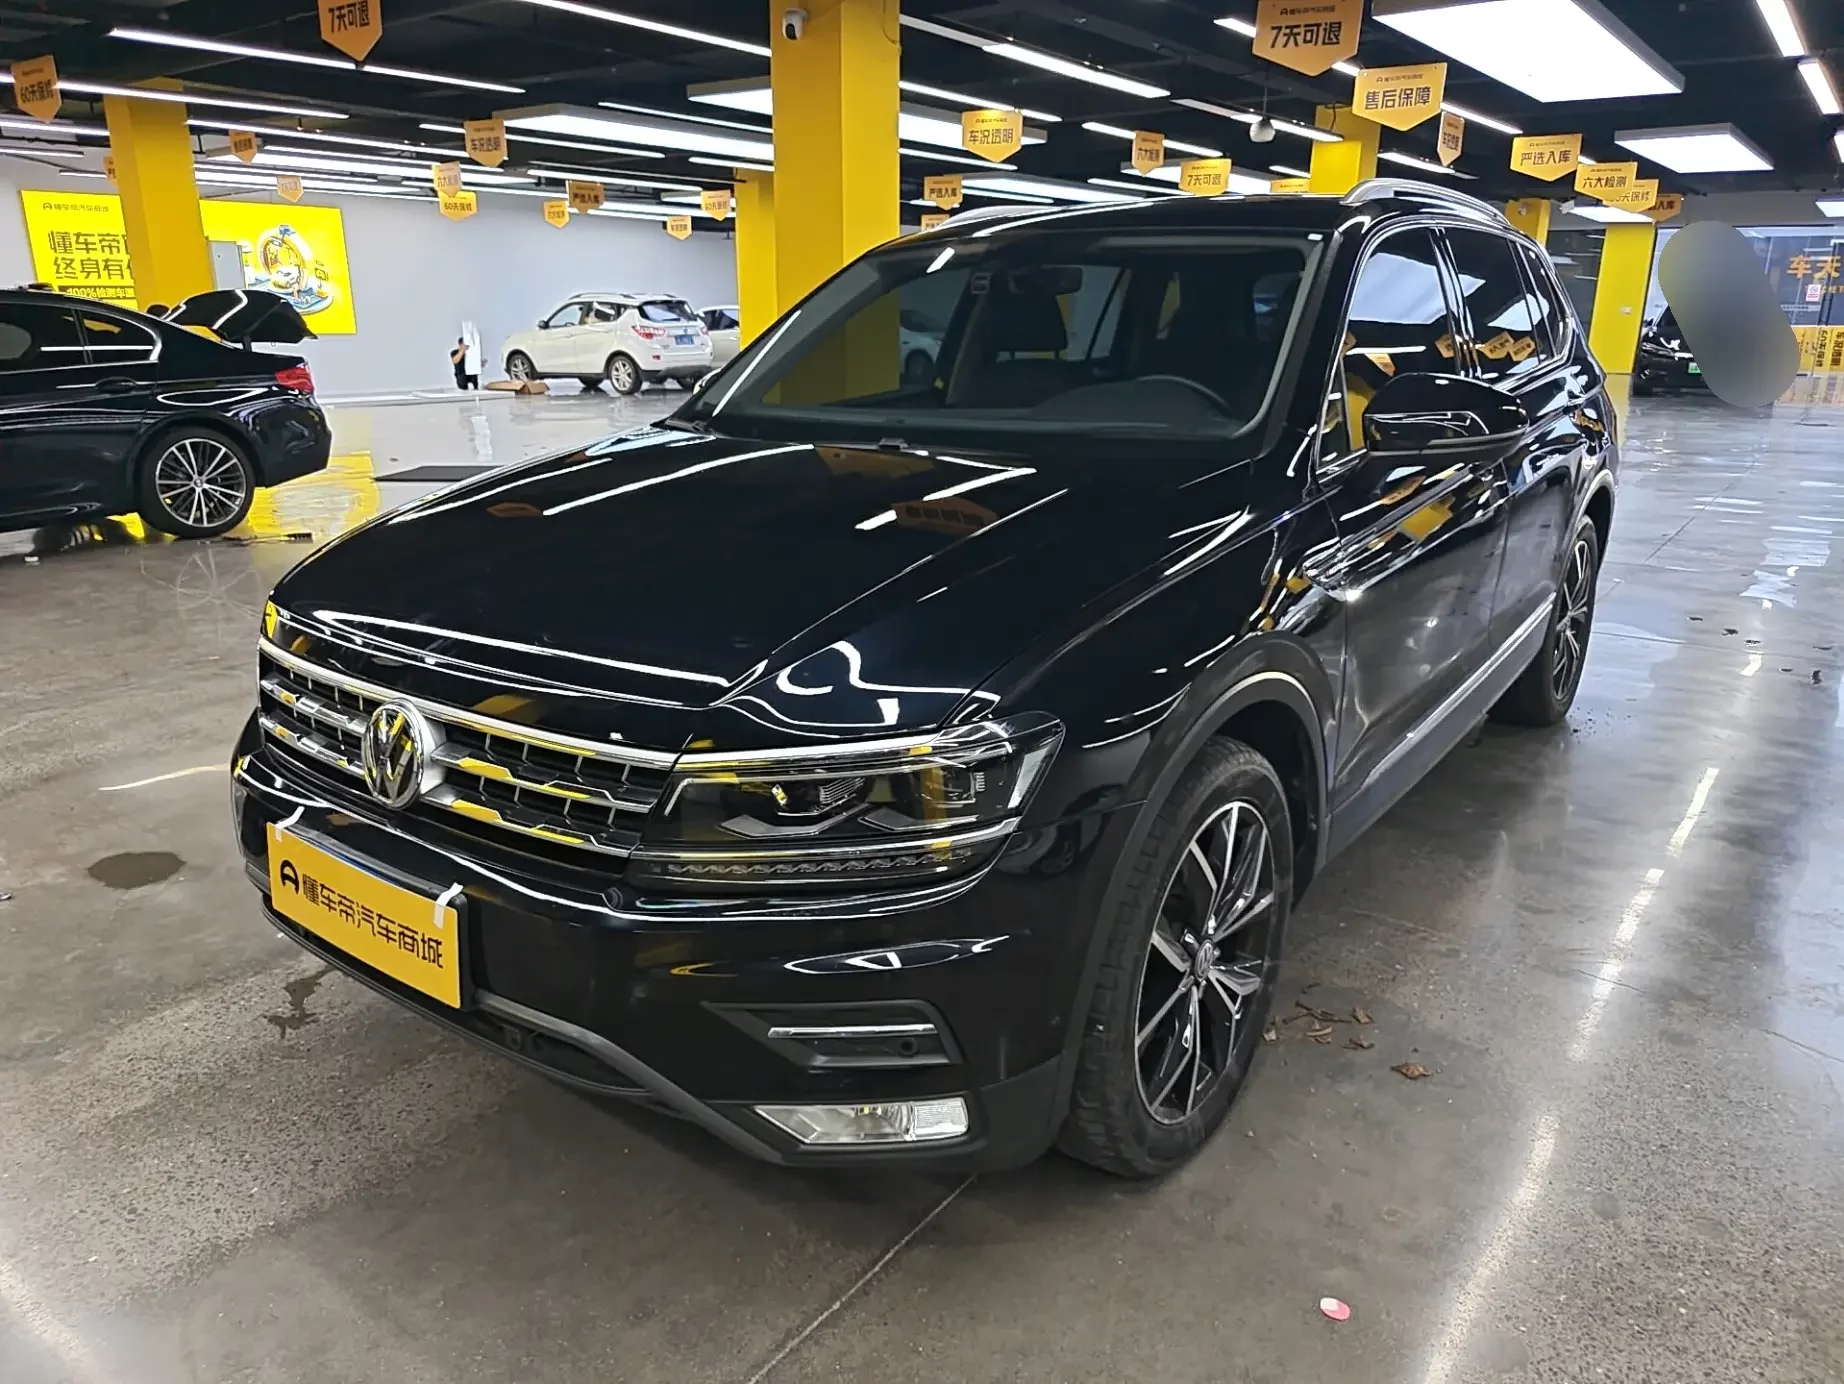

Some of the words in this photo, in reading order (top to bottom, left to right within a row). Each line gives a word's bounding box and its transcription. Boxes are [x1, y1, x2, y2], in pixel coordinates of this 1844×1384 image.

[328, 0, 370, 33] 7天可退
[1270, 21, 1342, 48] 7天可退
[1365, 86, 1431, 110] 售后保障
[968, 128, 1014, 145] 车况透明
[1520, 150, 1572, 166] 严选入库
[1187, 174, 1223, 187] 7天可退
[1583, 176, 1628, 188] 六大检测
[929, 187, 958, 198] 严选入库
[302, 873, 444, 969] 懂车帝汽车商城
